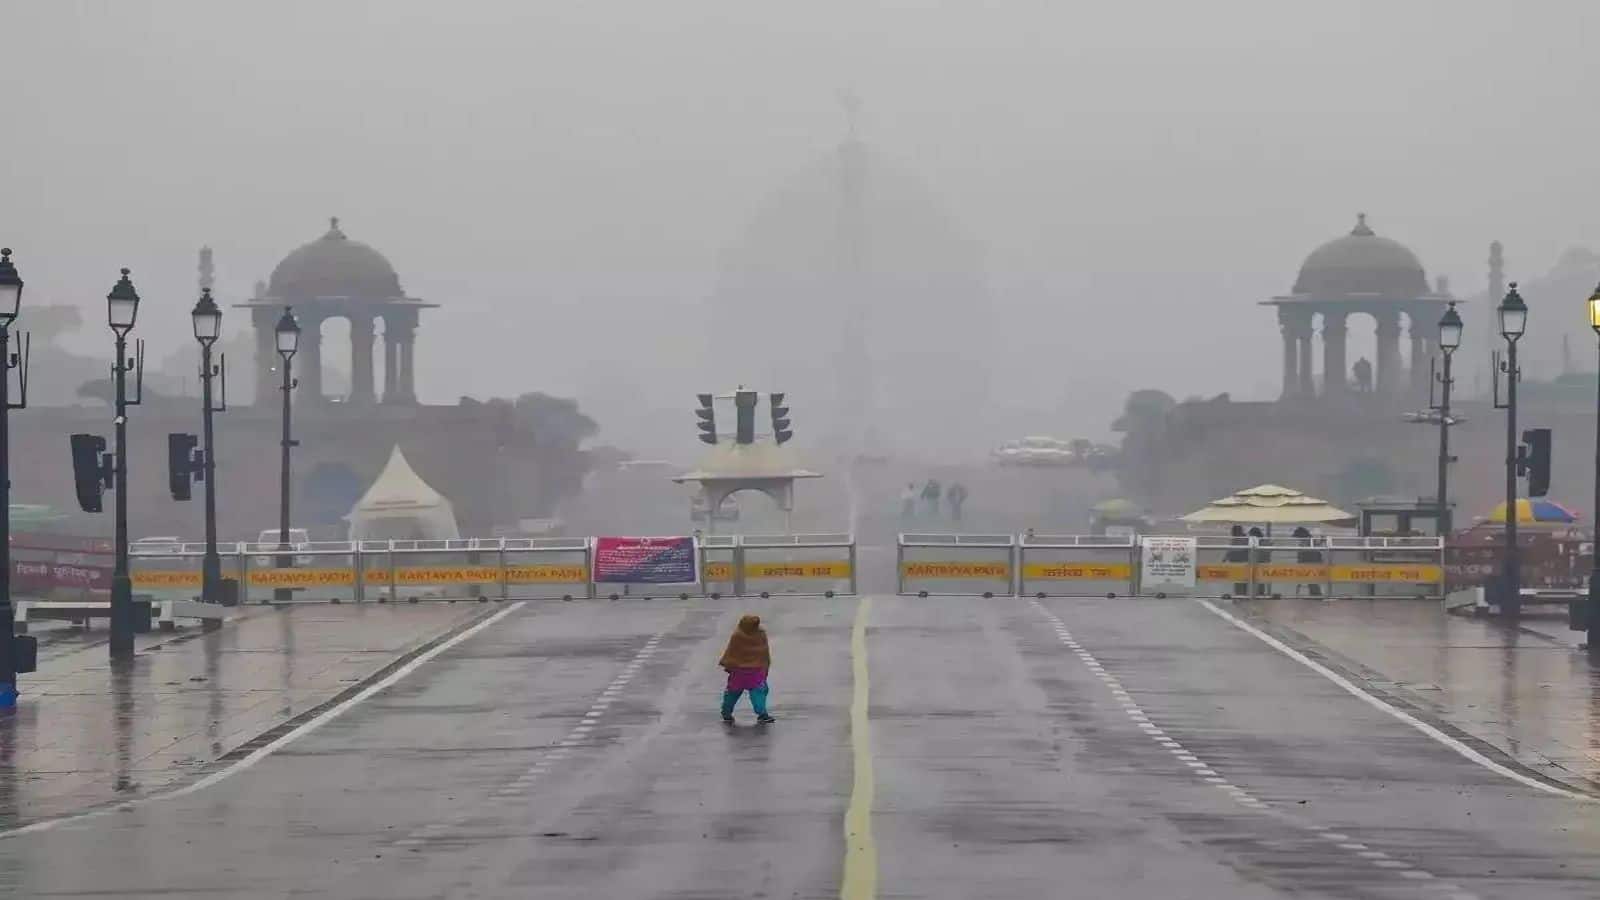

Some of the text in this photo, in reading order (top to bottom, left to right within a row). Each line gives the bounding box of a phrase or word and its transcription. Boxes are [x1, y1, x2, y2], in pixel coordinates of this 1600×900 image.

[399, 569, 497, 581] KARTAVYA PATH
[551, 568, 583, 578] PATH
[906, 565, 1005, 577] KARTAVYA PATH
[251, 571, 352, 584] KARTAVYA PATH
